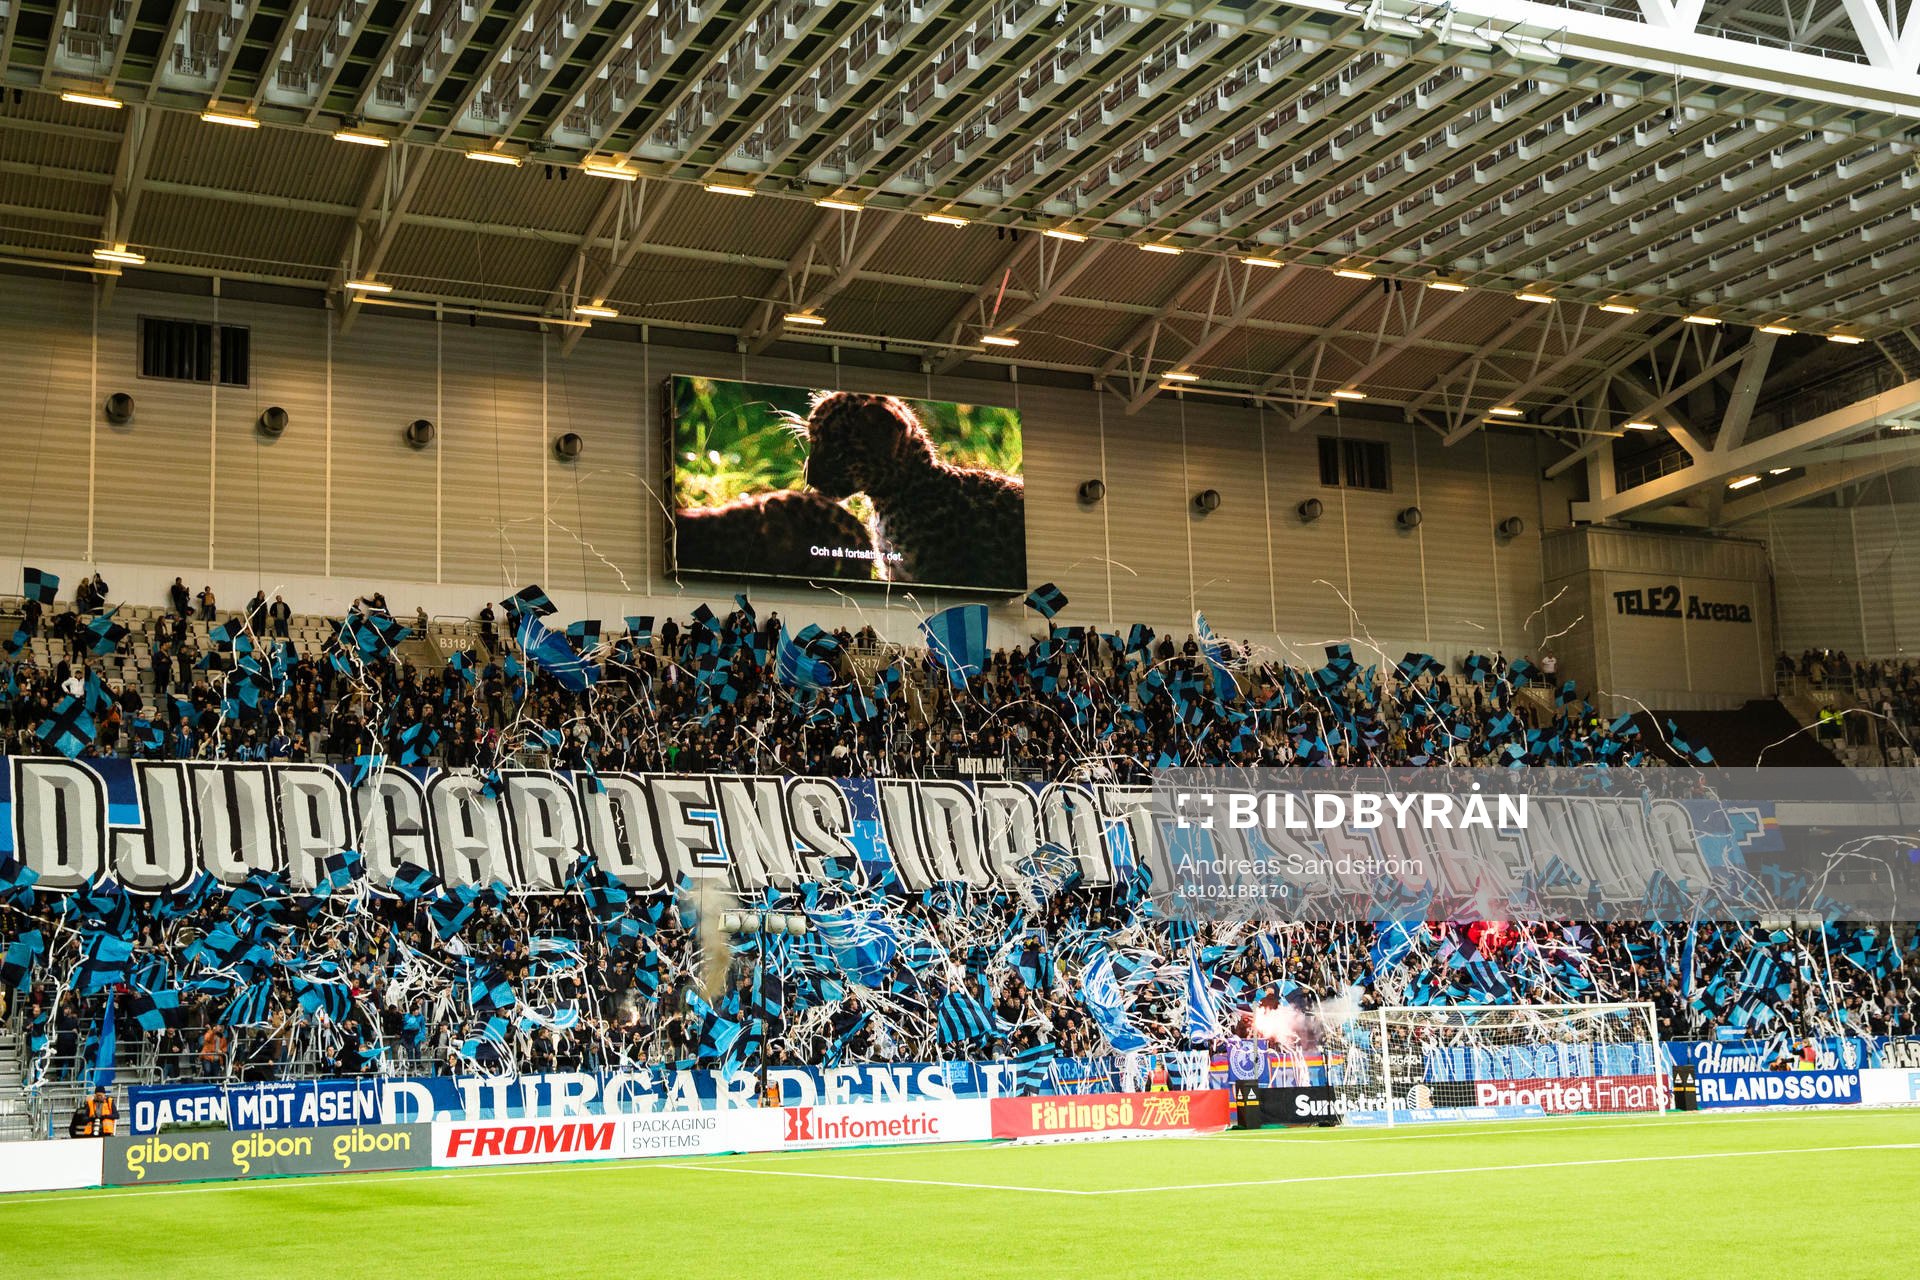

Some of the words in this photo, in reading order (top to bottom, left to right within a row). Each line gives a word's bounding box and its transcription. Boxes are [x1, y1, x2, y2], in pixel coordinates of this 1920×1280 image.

[810, 546, 829, 556] Och
[832, 547, 843, 557] så
[887, 551, 904, 561] det.
[1613, 585, 1682, 618] TELE2
[1687, 595, 1752, 623] Arena
[440, 637, 466, 648] B318
[1295, 1090, 1407, 1117] Sundström
[1477, 1080, 1592, 1111] Prioritet
[1595, 1079, 1669, 1109] Finans
[135, 1096, 228, 1132] OASEN
[238, 1093, 296, 1126] MOT
[632, 1117, 716, 1132] PACKAGING
[817, 1112, 939, 1140] Infometric
[1031, 1098, 1134, 1130] Färingsö
[1140, 1095, 1190, 1126] TRÄ
[126, 1137, 210, 1180] gibon
[232, 1133, 313, 1175] gibon
[333, 1128, 411, 1169] gibon
[446, 1121, 616, 1158] FROMM
[632, 1134, 700, 1150] SYSTEMS
